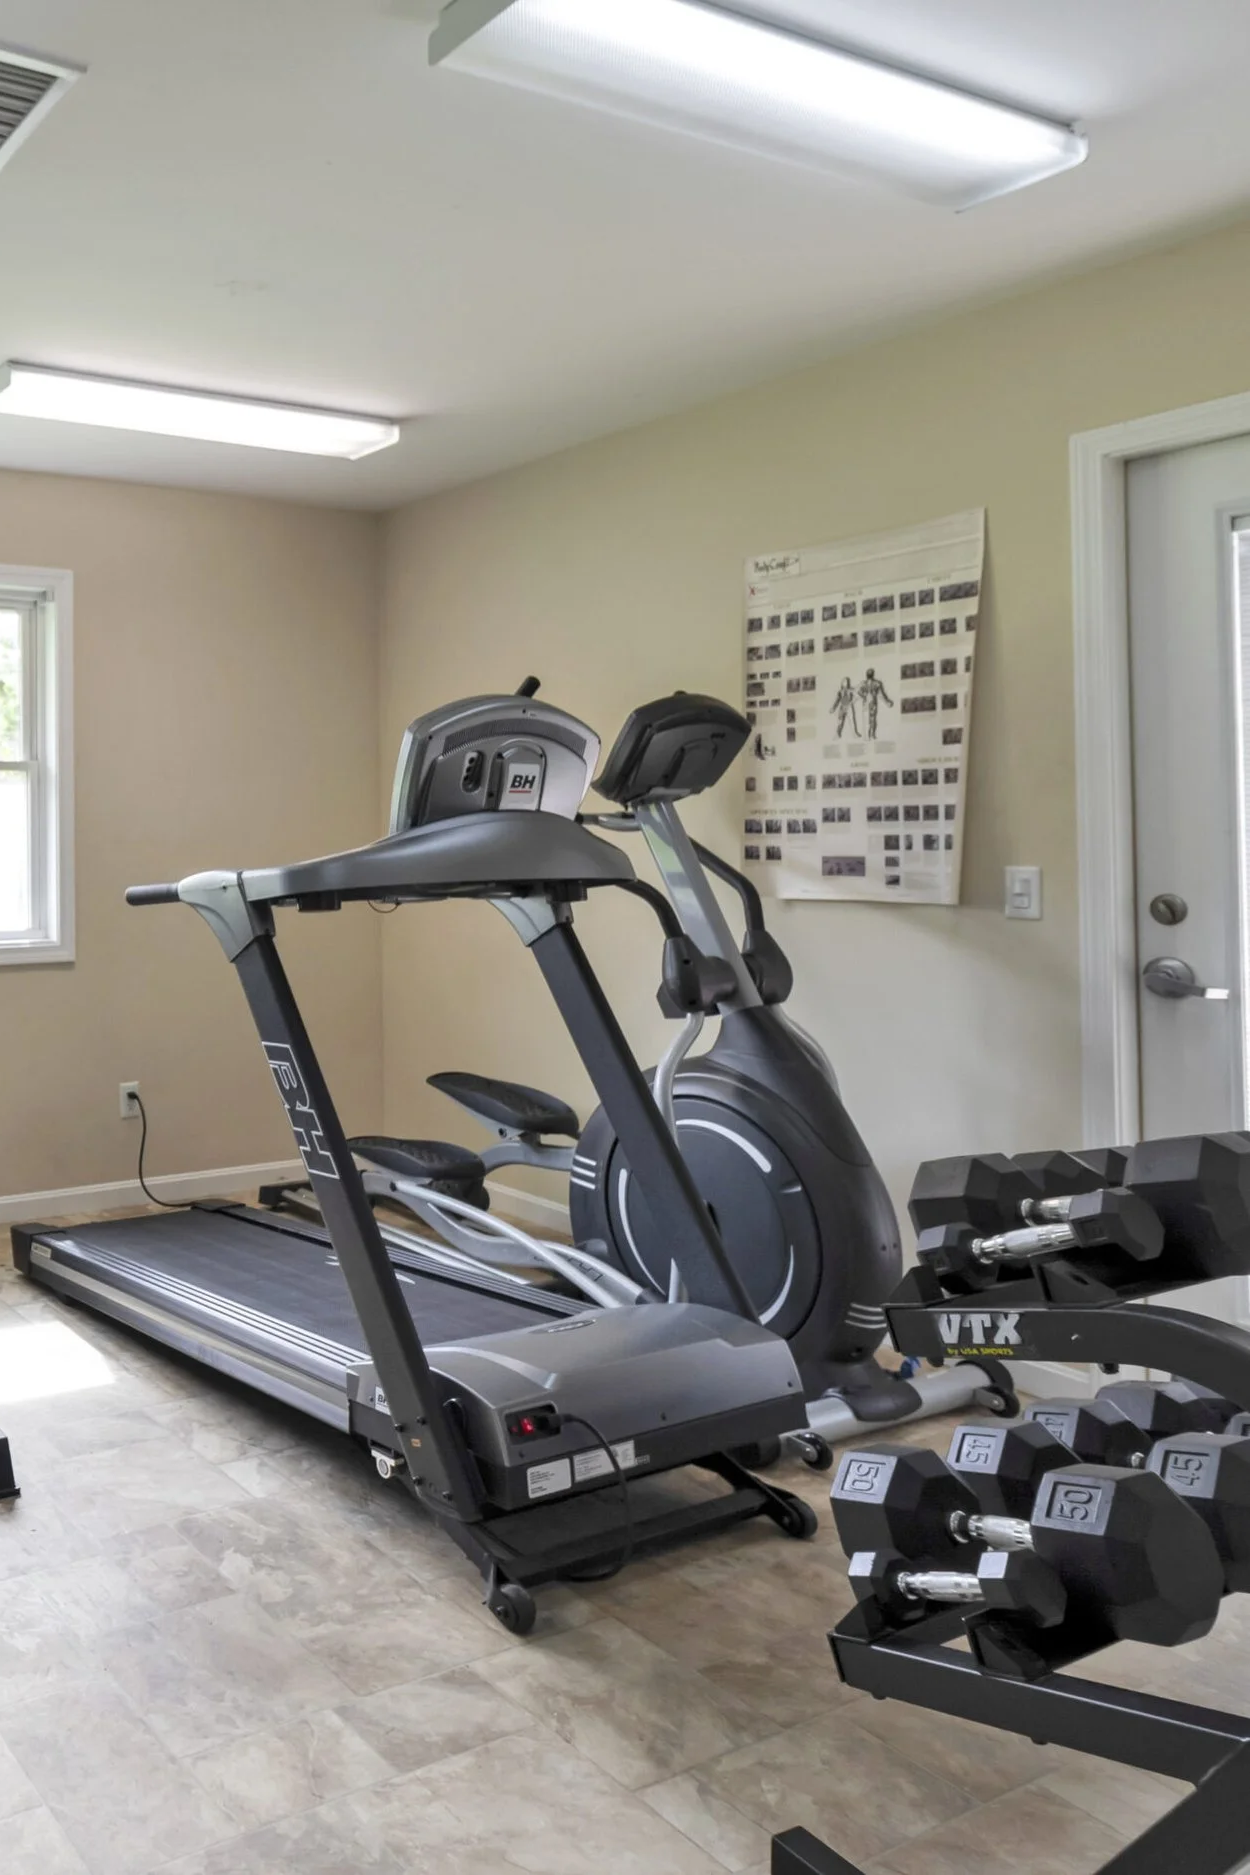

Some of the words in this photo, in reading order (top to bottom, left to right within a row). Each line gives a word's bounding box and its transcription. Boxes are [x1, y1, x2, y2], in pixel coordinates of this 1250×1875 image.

[510, 774, 536, 789] BH
[261, 1040, 341, 1180] BH
[937, 1312, 1023, 1345] VTX
[965, 1439, 991, 1465] 45
[849, 1463, 880, 1492] 50
[1170, 1455, 1204, 1487] 45
[1056, 1489, 1094, 1521] 50
